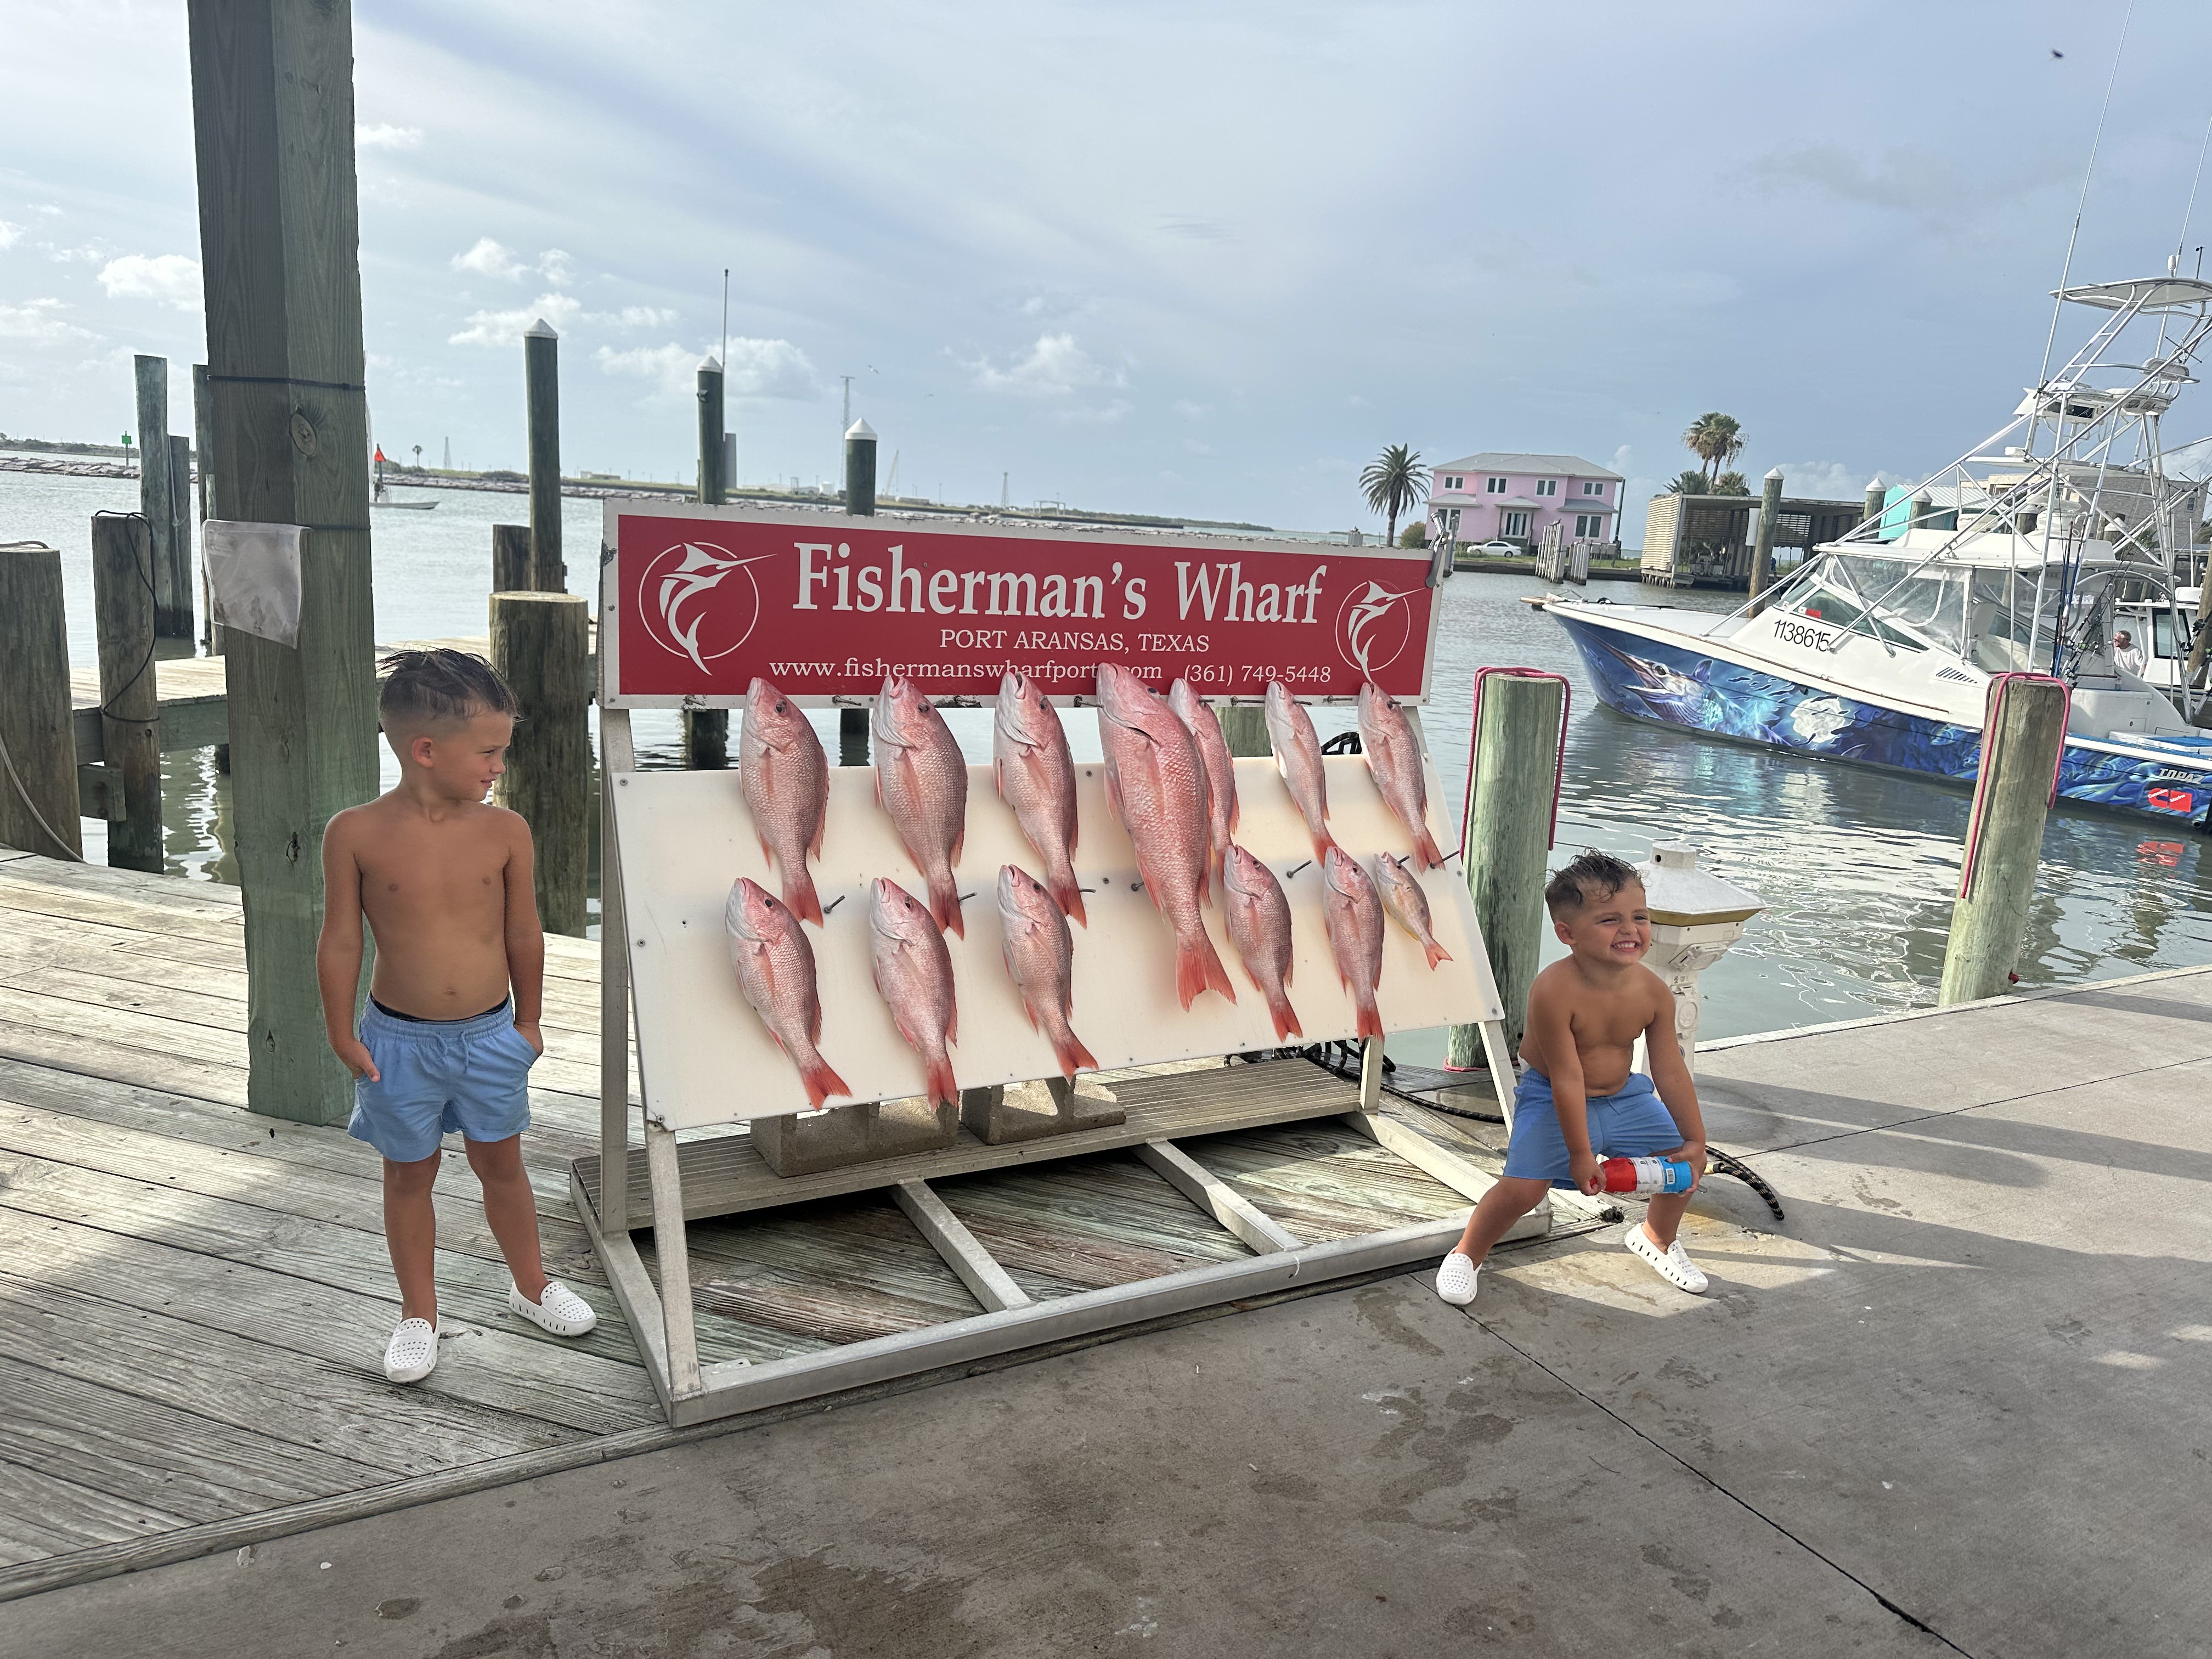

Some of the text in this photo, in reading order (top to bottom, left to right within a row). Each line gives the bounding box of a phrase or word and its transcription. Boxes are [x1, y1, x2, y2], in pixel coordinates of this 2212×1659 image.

[793, 542, 1327, 623] Fisherman's Wharf
[939, 629, 1210, 654] PORT ARANSAS, TEXAS
[1774, 619, 1831, 652] 1138615
[1183, 664, 1233, 687] (361)
[1241, 665, 1331, 682] 749-5448
[2159, 768, 2205, 785] TOPAZ
